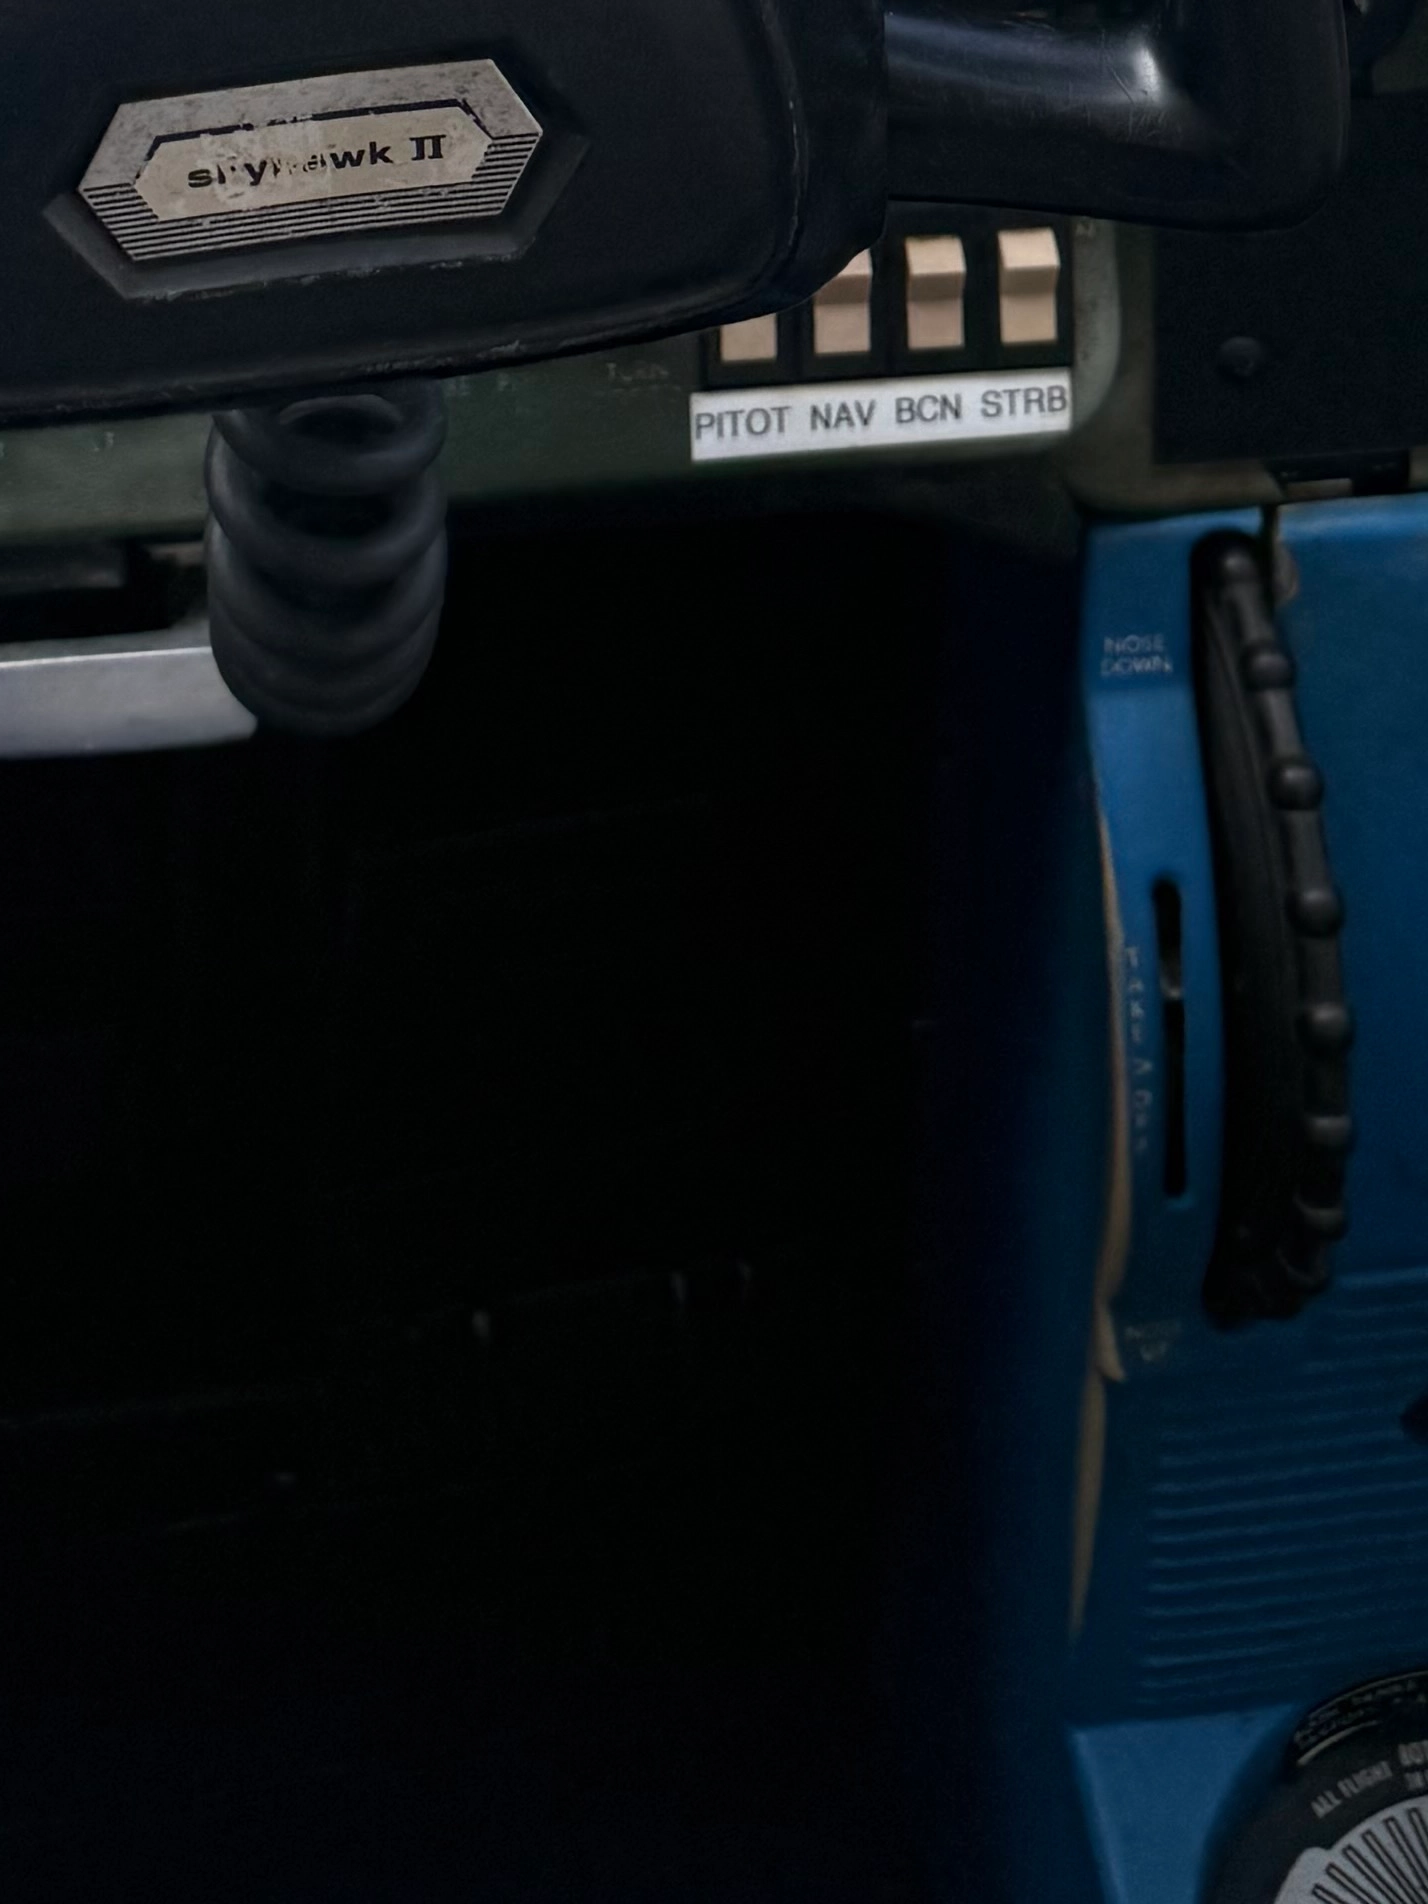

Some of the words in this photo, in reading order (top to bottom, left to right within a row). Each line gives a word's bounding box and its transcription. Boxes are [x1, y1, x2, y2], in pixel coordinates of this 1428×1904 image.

[695, 406, 791, 440] PITOT
[810, 400, 878, 431] NAV
[894, 394, 963, 424] BCN
[980, 385, 1069, 419] STRB
